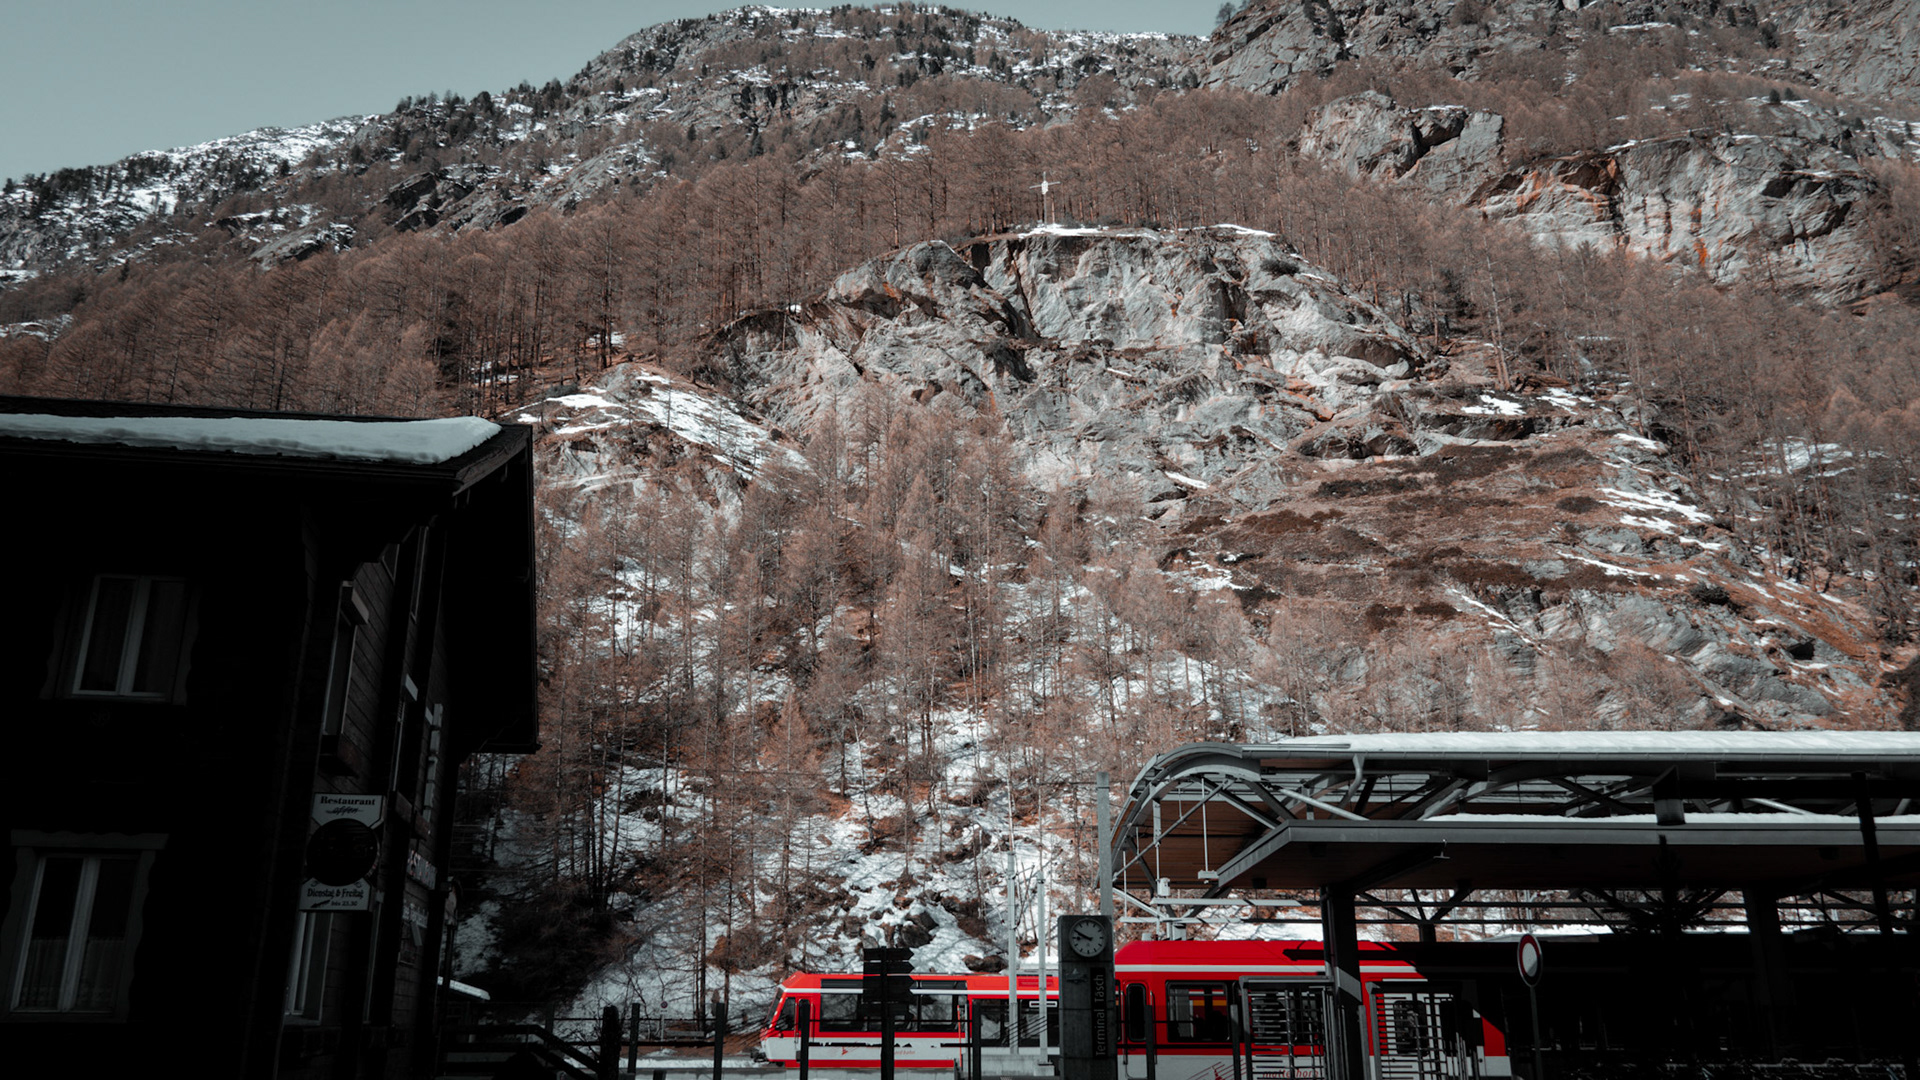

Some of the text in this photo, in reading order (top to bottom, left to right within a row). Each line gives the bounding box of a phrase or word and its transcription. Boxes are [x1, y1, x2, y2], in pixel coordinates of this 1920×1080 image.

[320, 796, 375, 805] Restaurant
[307, 888, 334, 899] Dienstag
[342, 888, 364, 899] Freitag
[1094, 1009, 1106, 1056] Terminal
[1262, 1068, 1319, 1078] mattehorn
